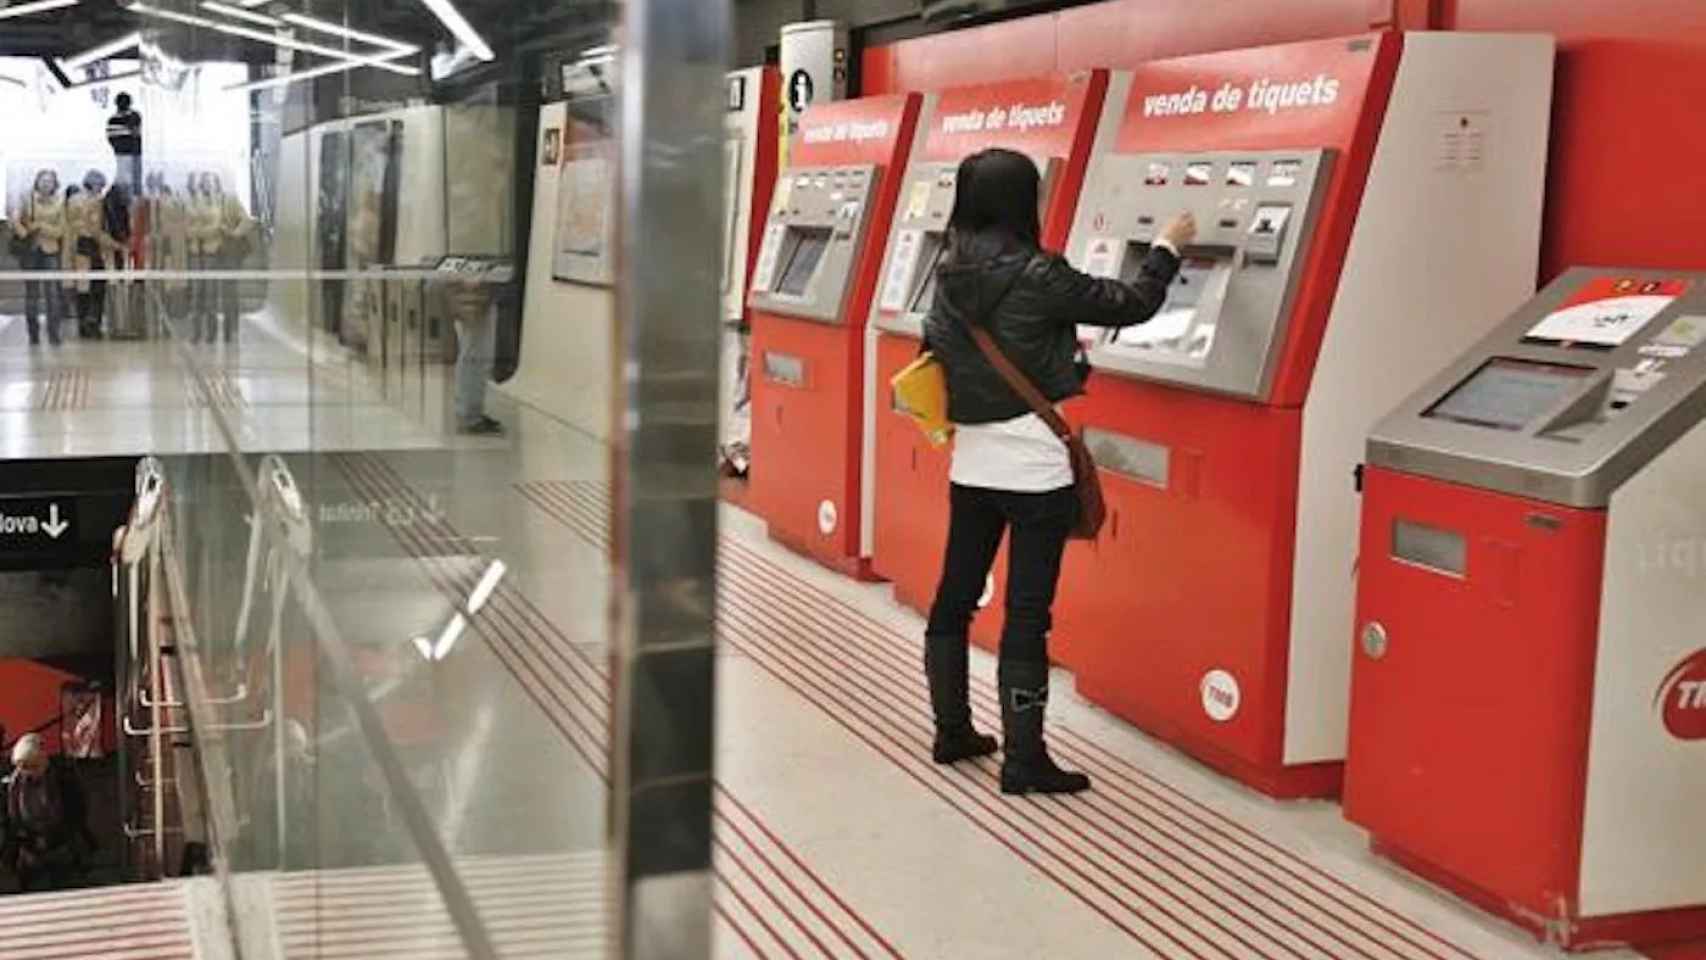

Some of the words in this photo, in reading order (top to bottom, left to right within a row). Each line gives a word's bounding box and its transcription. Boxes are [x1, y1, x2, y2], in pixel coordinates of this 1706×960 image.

[1144, 85, 1207, 117] venda
[1211, 82, 1243, 112] de
[1248, 74, 1339, 115] tiquets
[943, 108, 985, 133] venda
[986, 106, 1006, 129] de
[1008, 100, 1065, 133] tiquets
[0, 513, 38, 533] ova
